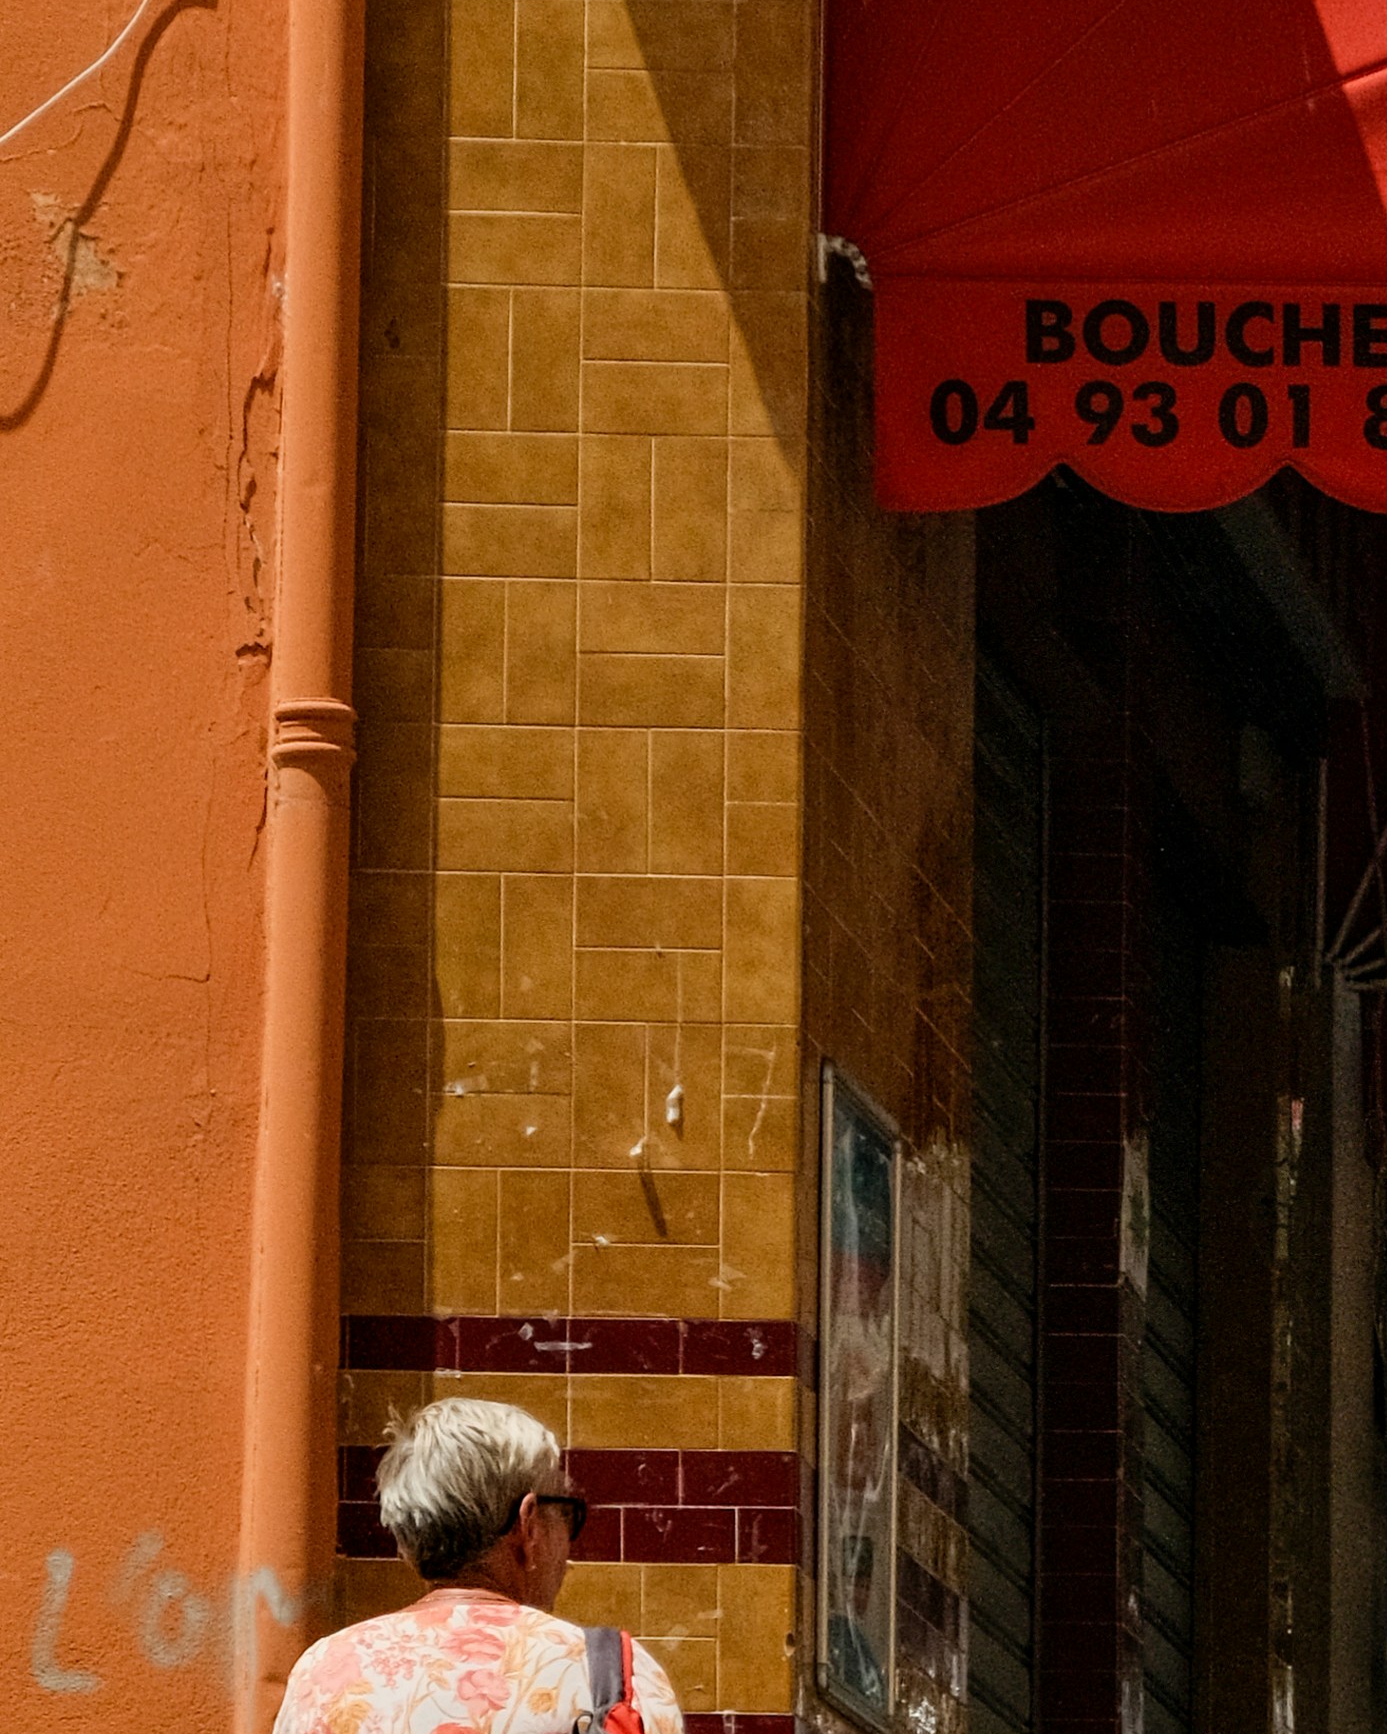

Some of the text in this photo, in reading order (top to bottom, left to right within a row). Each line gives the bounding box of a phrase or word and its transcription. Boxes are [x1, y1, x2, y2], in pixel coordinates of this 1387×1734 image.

[929, 378, 1036, 446] 04
[1074, 379, 1180, 449] 93
[1217, 381, 1311, 449] 01
